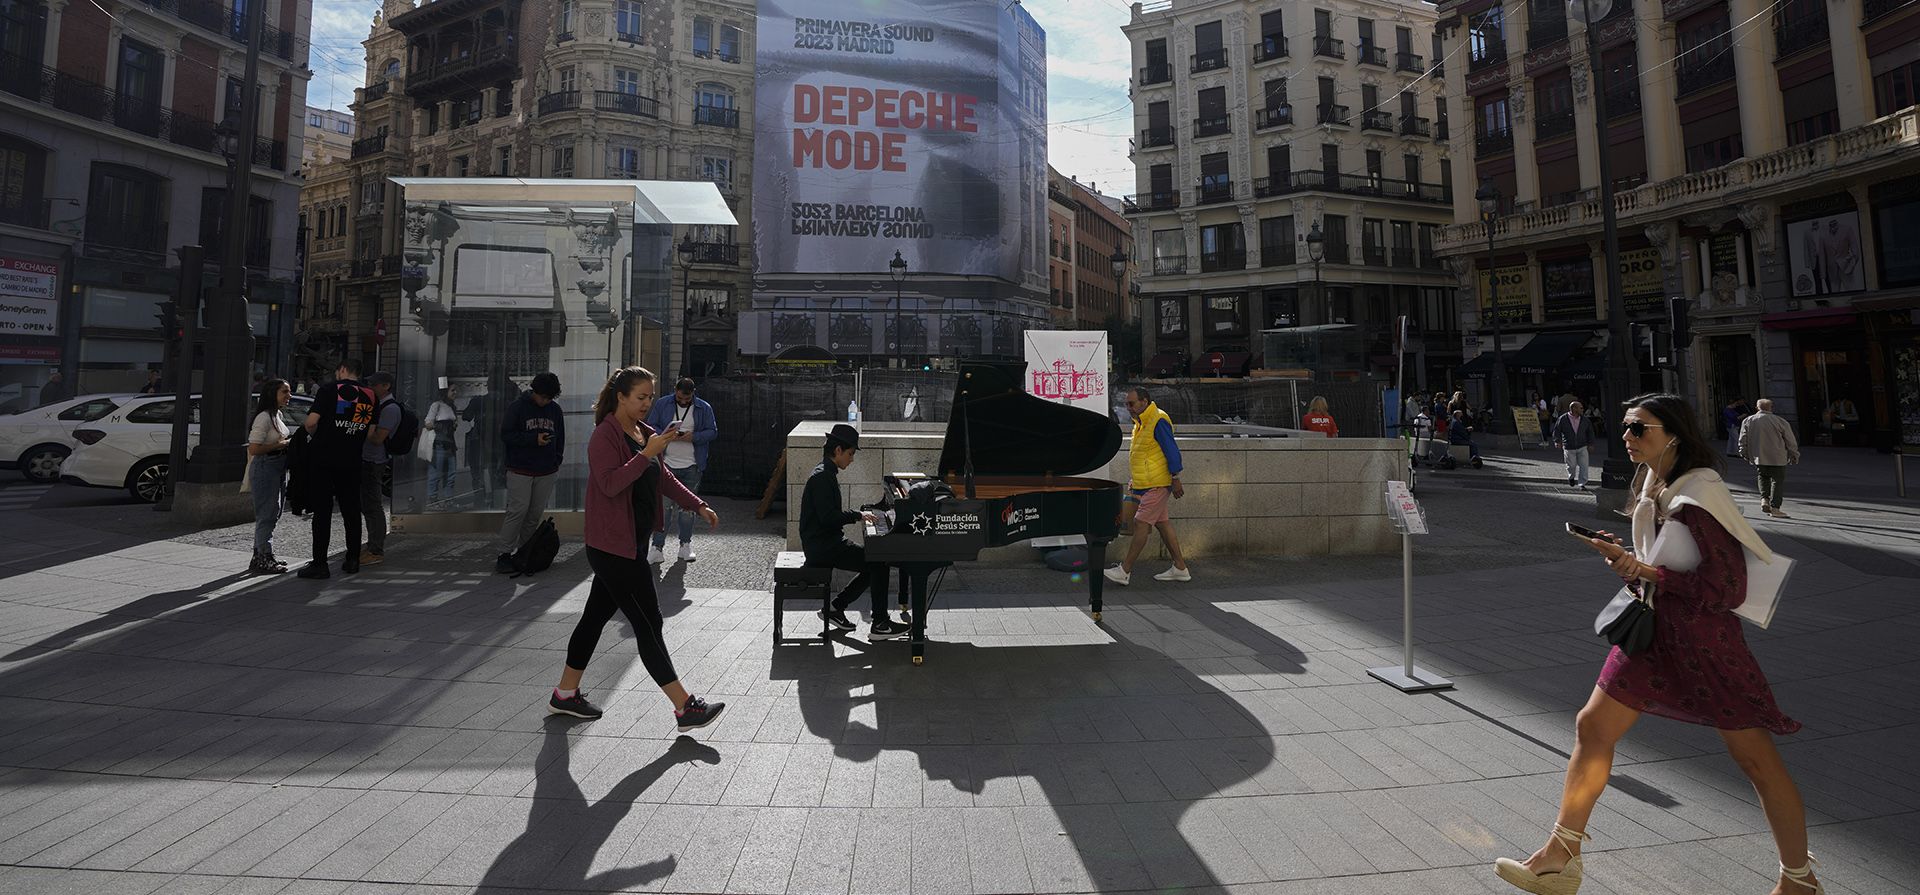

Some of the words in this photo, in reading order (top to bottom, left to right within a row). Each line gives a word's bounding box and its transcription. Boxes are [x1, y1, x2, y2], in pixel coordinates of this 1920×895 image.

[795, 17, 882, 38] PRIMAVERA
[884, 24, 934, 42] SOUND
[794, 32, 834, 50] 2023
[837, 36, 895, 54] MADRID
[794, 84, 978, 133] DEPECHE
[793, 128, 907, 172] MODE
[1619, 250, 1658, 260] MPEÑO
[15, 261, 57, 274] EXCHANGE
[1619, 260, 1656, 274] ORO
[1, 283, 20, 292] CAMBIO
[23, 322, 45, 331] OPEN
[45, 411, 53, 420] X
[111, 413, 121, 423] M
[935, 513, 979, 523] Fundación
[935, 522, 958, 530] Jesús
[958, 521, 981, 530] Serra
